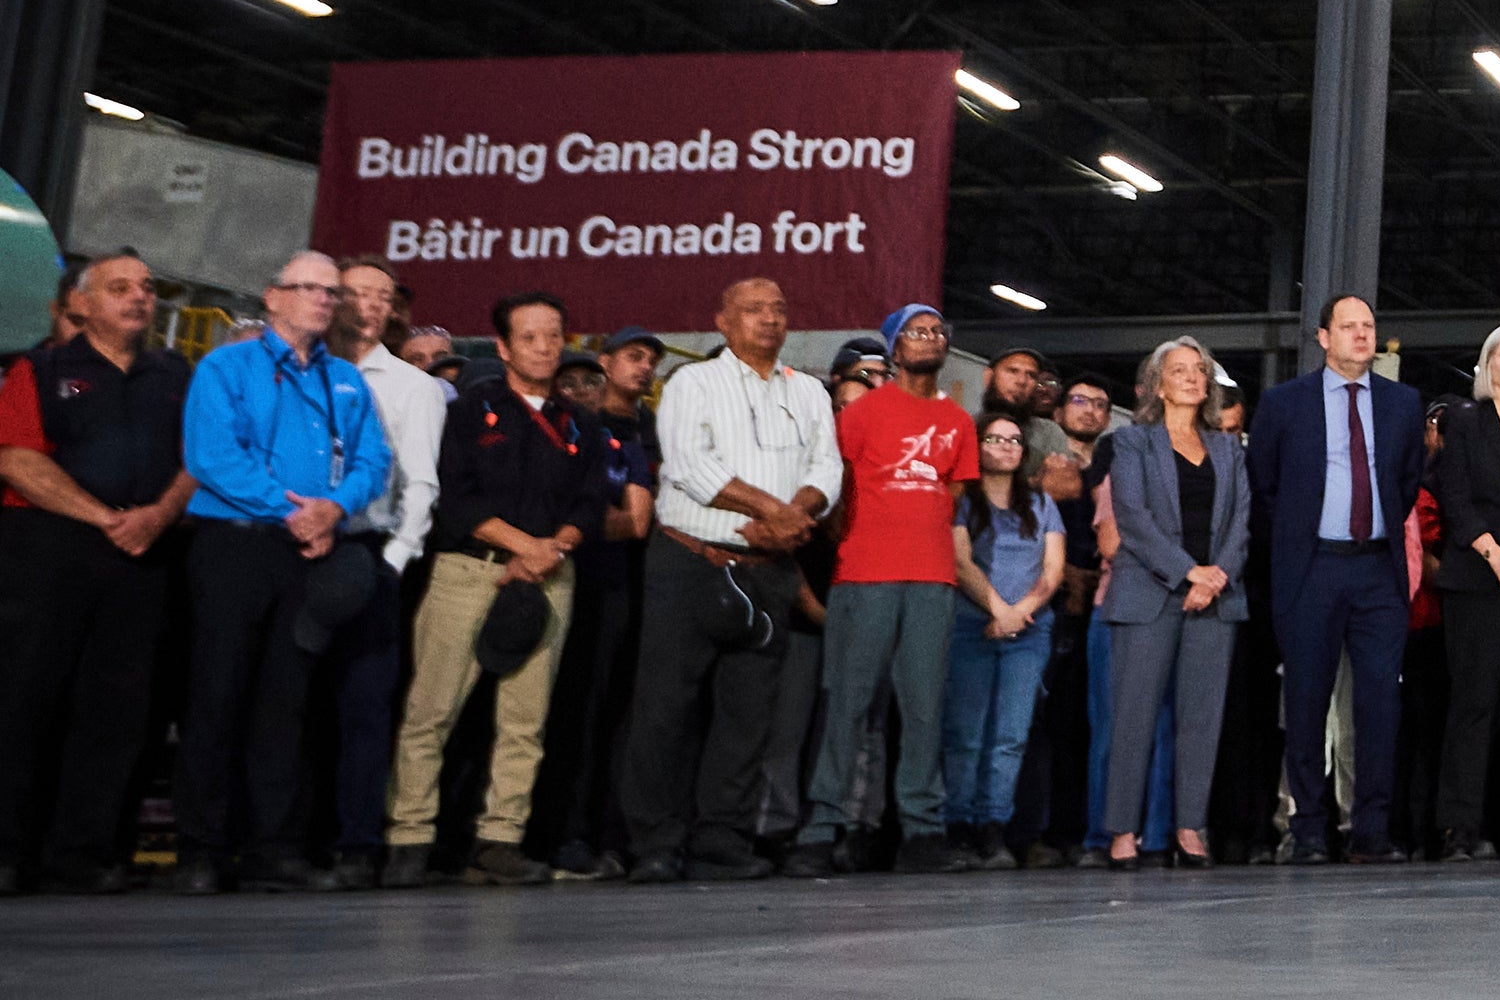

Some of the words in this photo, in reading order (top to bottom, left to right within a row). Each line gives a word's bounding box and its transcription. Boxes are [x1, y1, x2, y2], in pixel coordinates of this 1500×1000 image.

[358, 134, 547, 183] Building
[557, 129, 739, 173] Canada
[748, 128, 915, 177] Strong
[387, 217, 503, 260] Bâtir
[511, 227, 570, 258] un
[579, 212, 762, 256] Canada
[772, 210, 868, 253] fort
